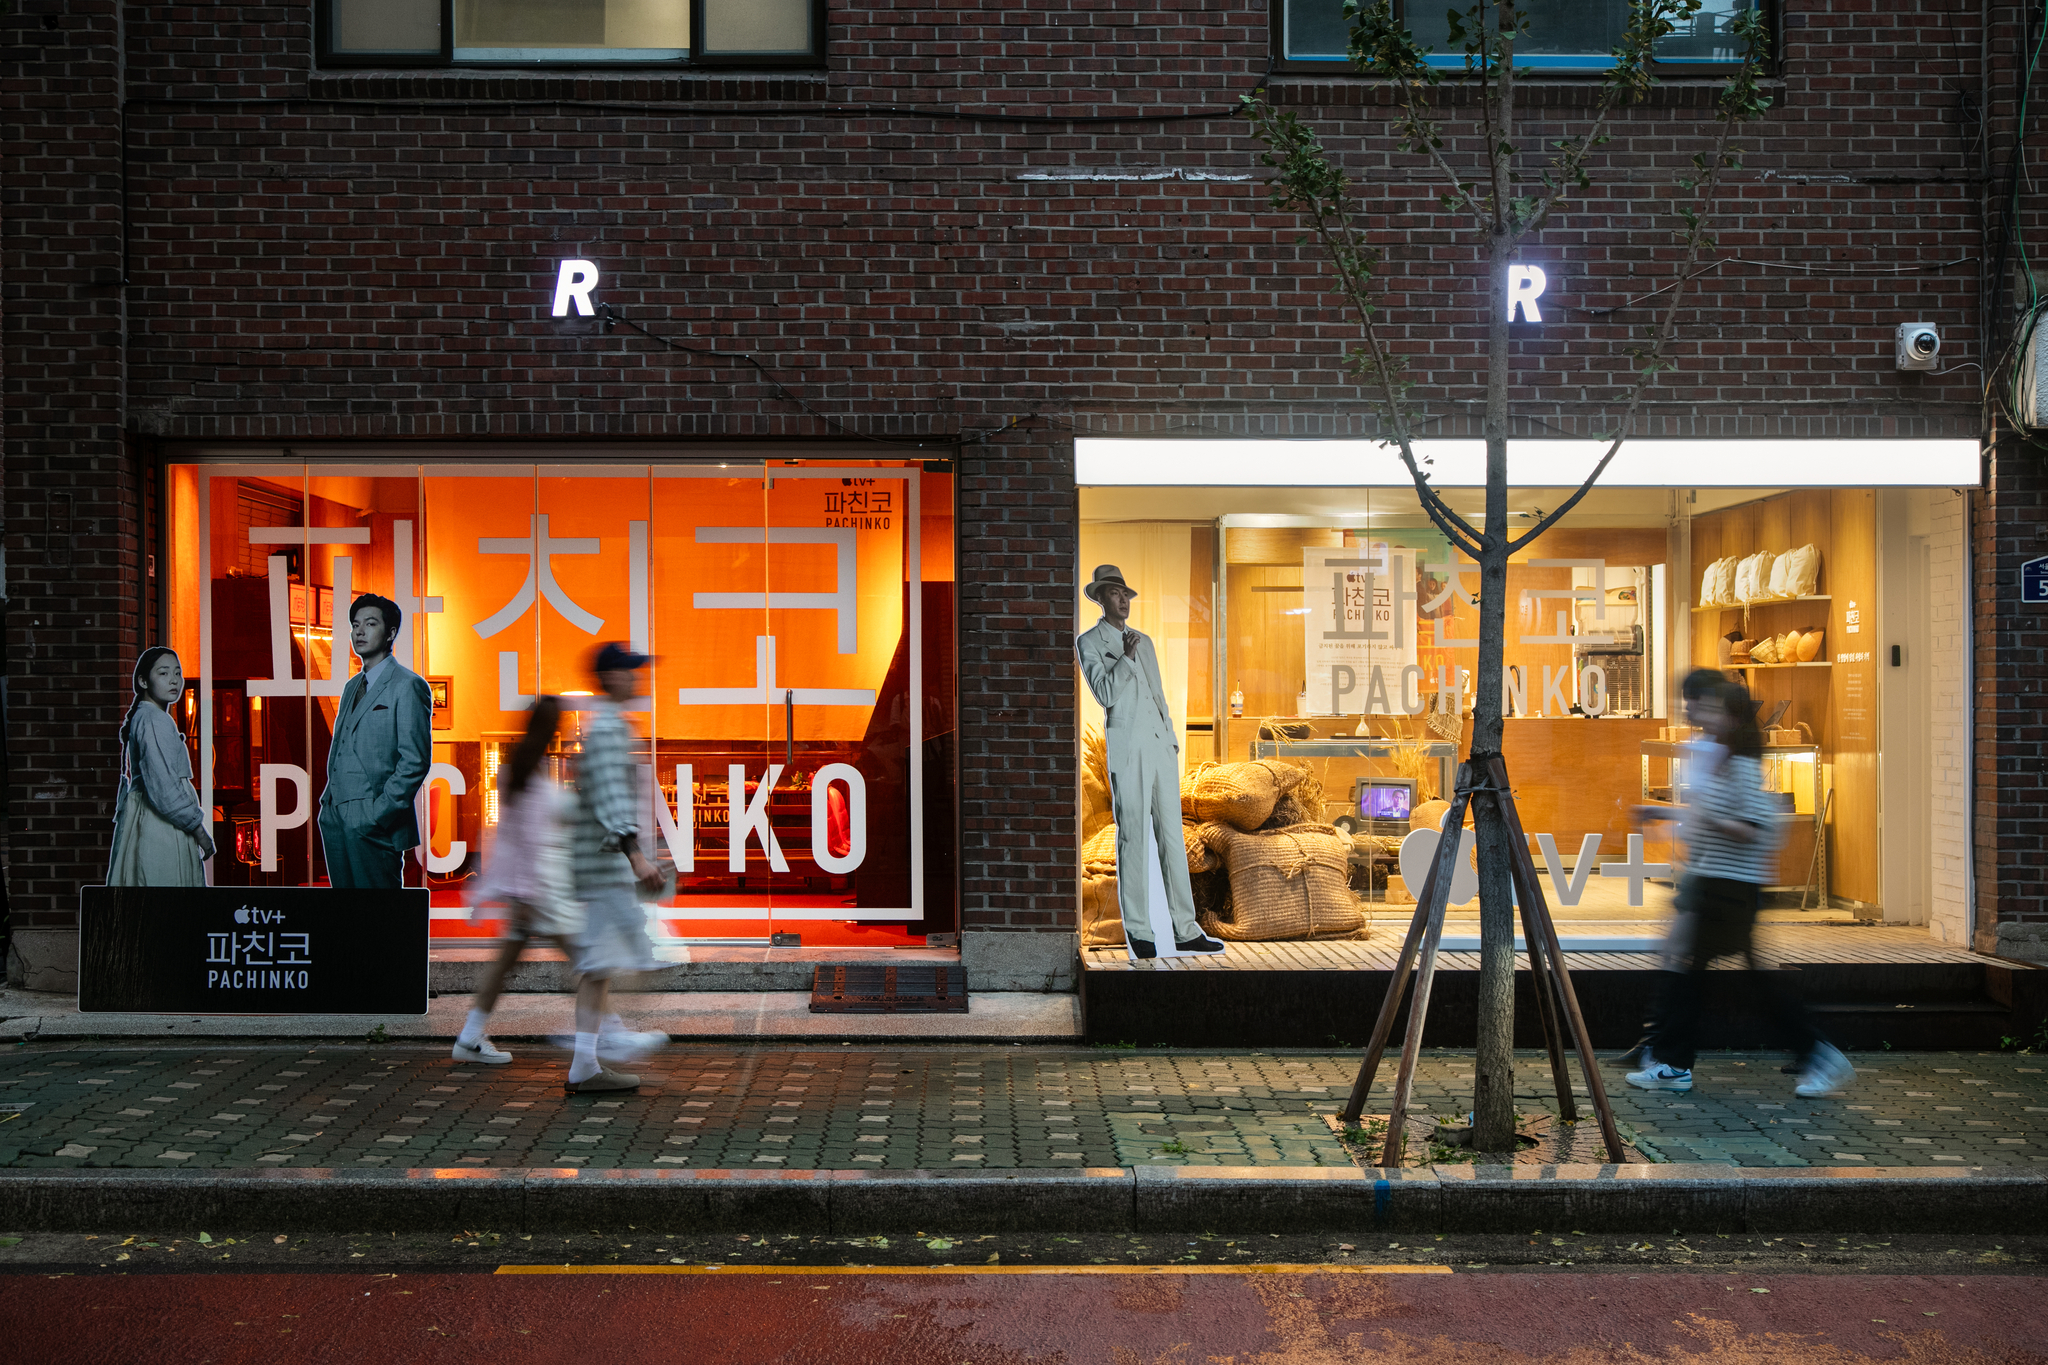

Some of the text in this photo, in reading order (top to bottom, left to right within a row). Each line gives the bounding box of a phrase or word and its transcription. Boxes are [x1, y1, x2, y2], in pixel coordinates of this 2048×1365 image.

[551, 260, 599, 316] R
[1508, 265, 1546, 322] R
[824, 491, 892, 514] 파친코
[826, 517, 890, 529] PACHINKO
[247, 514, 876, 711] 파친코
[1332, 664, 1606, 716] PACHNKO
[251, 907, 286, 924] tv+
[206, 931, 312, 965] 파친코
[208, 970, 309, 989] PACHINKO
